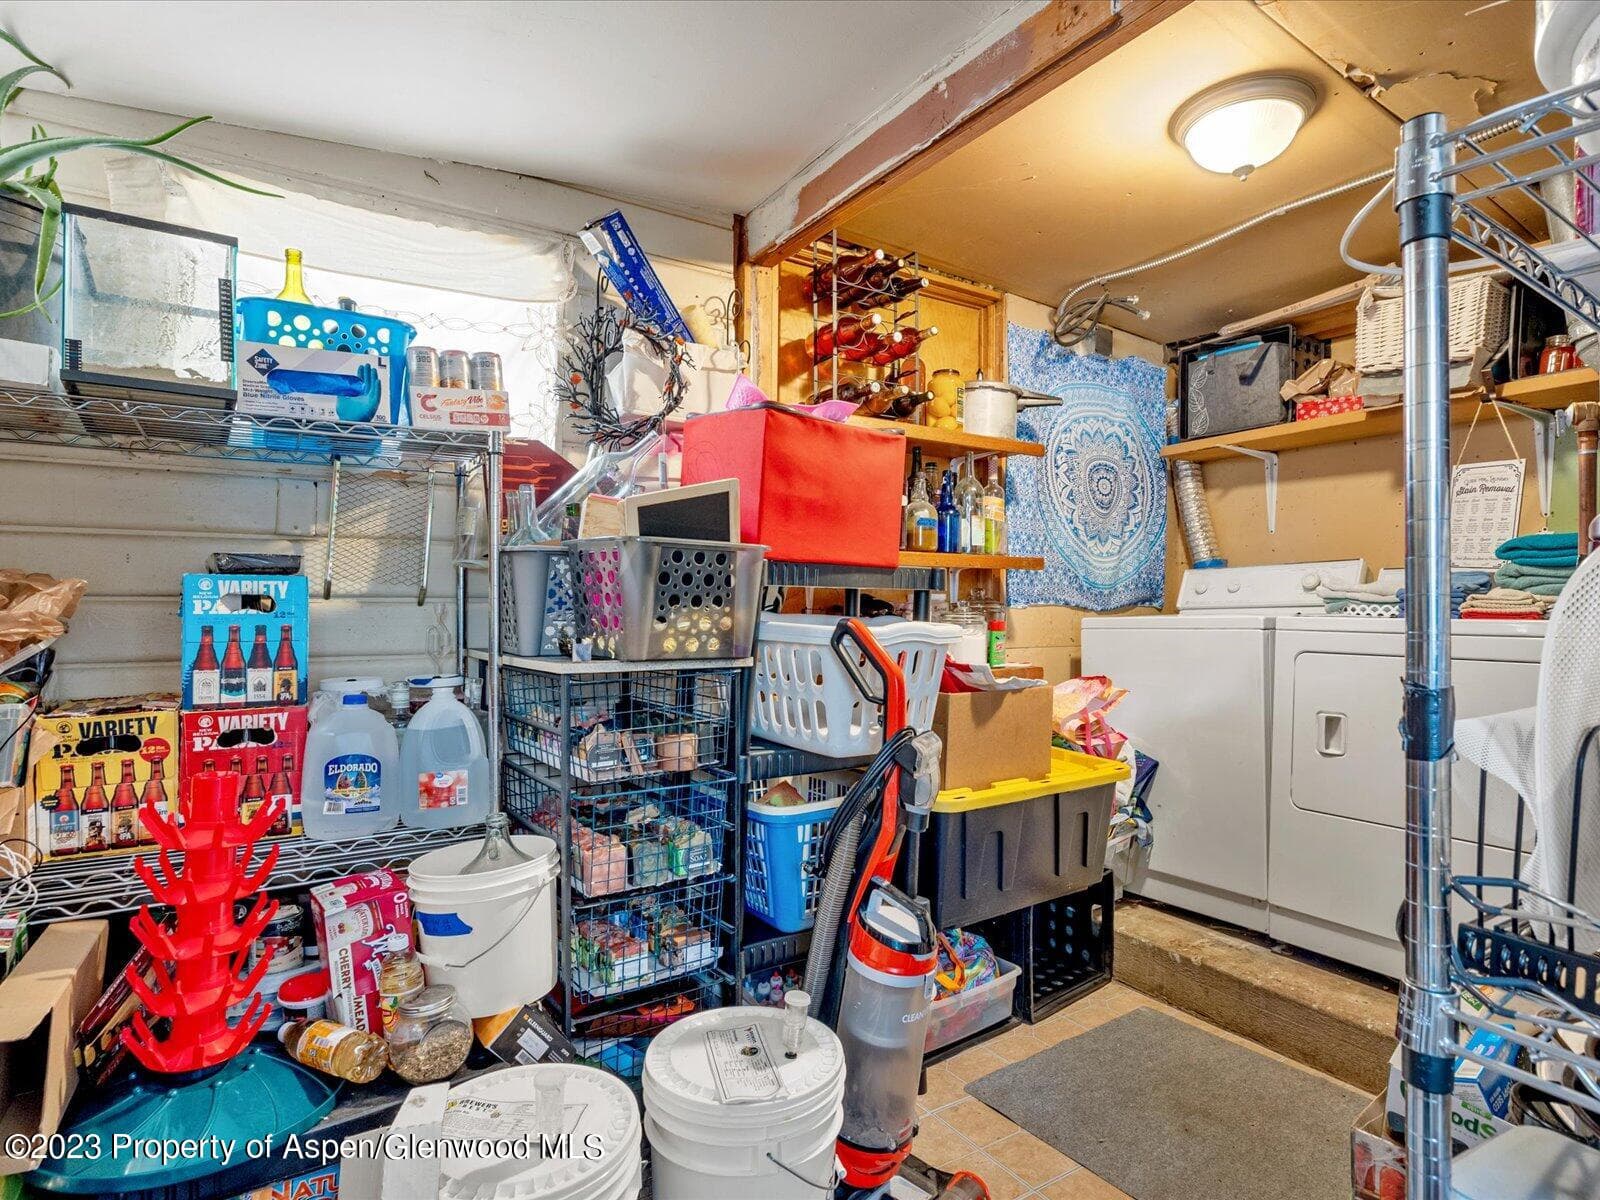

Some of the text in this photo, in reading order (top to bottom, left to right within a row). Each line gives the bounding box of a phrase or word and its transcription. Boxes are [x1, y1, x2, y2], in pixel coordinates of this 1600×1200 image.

[378, 357, 386, 368] L
[1456, 484, 1516, 497] Stain Removal
[218, 580, 289, 599] VARIETY
[78, 716, 158, 739] VARIETY
[218, 712, 289, 733] VARIETY
[328, 762, 378, 776] ELDORADO
[338, 948, 352, 990] CHERRY
[459, 1100, 498, 1110] BREWER'S
